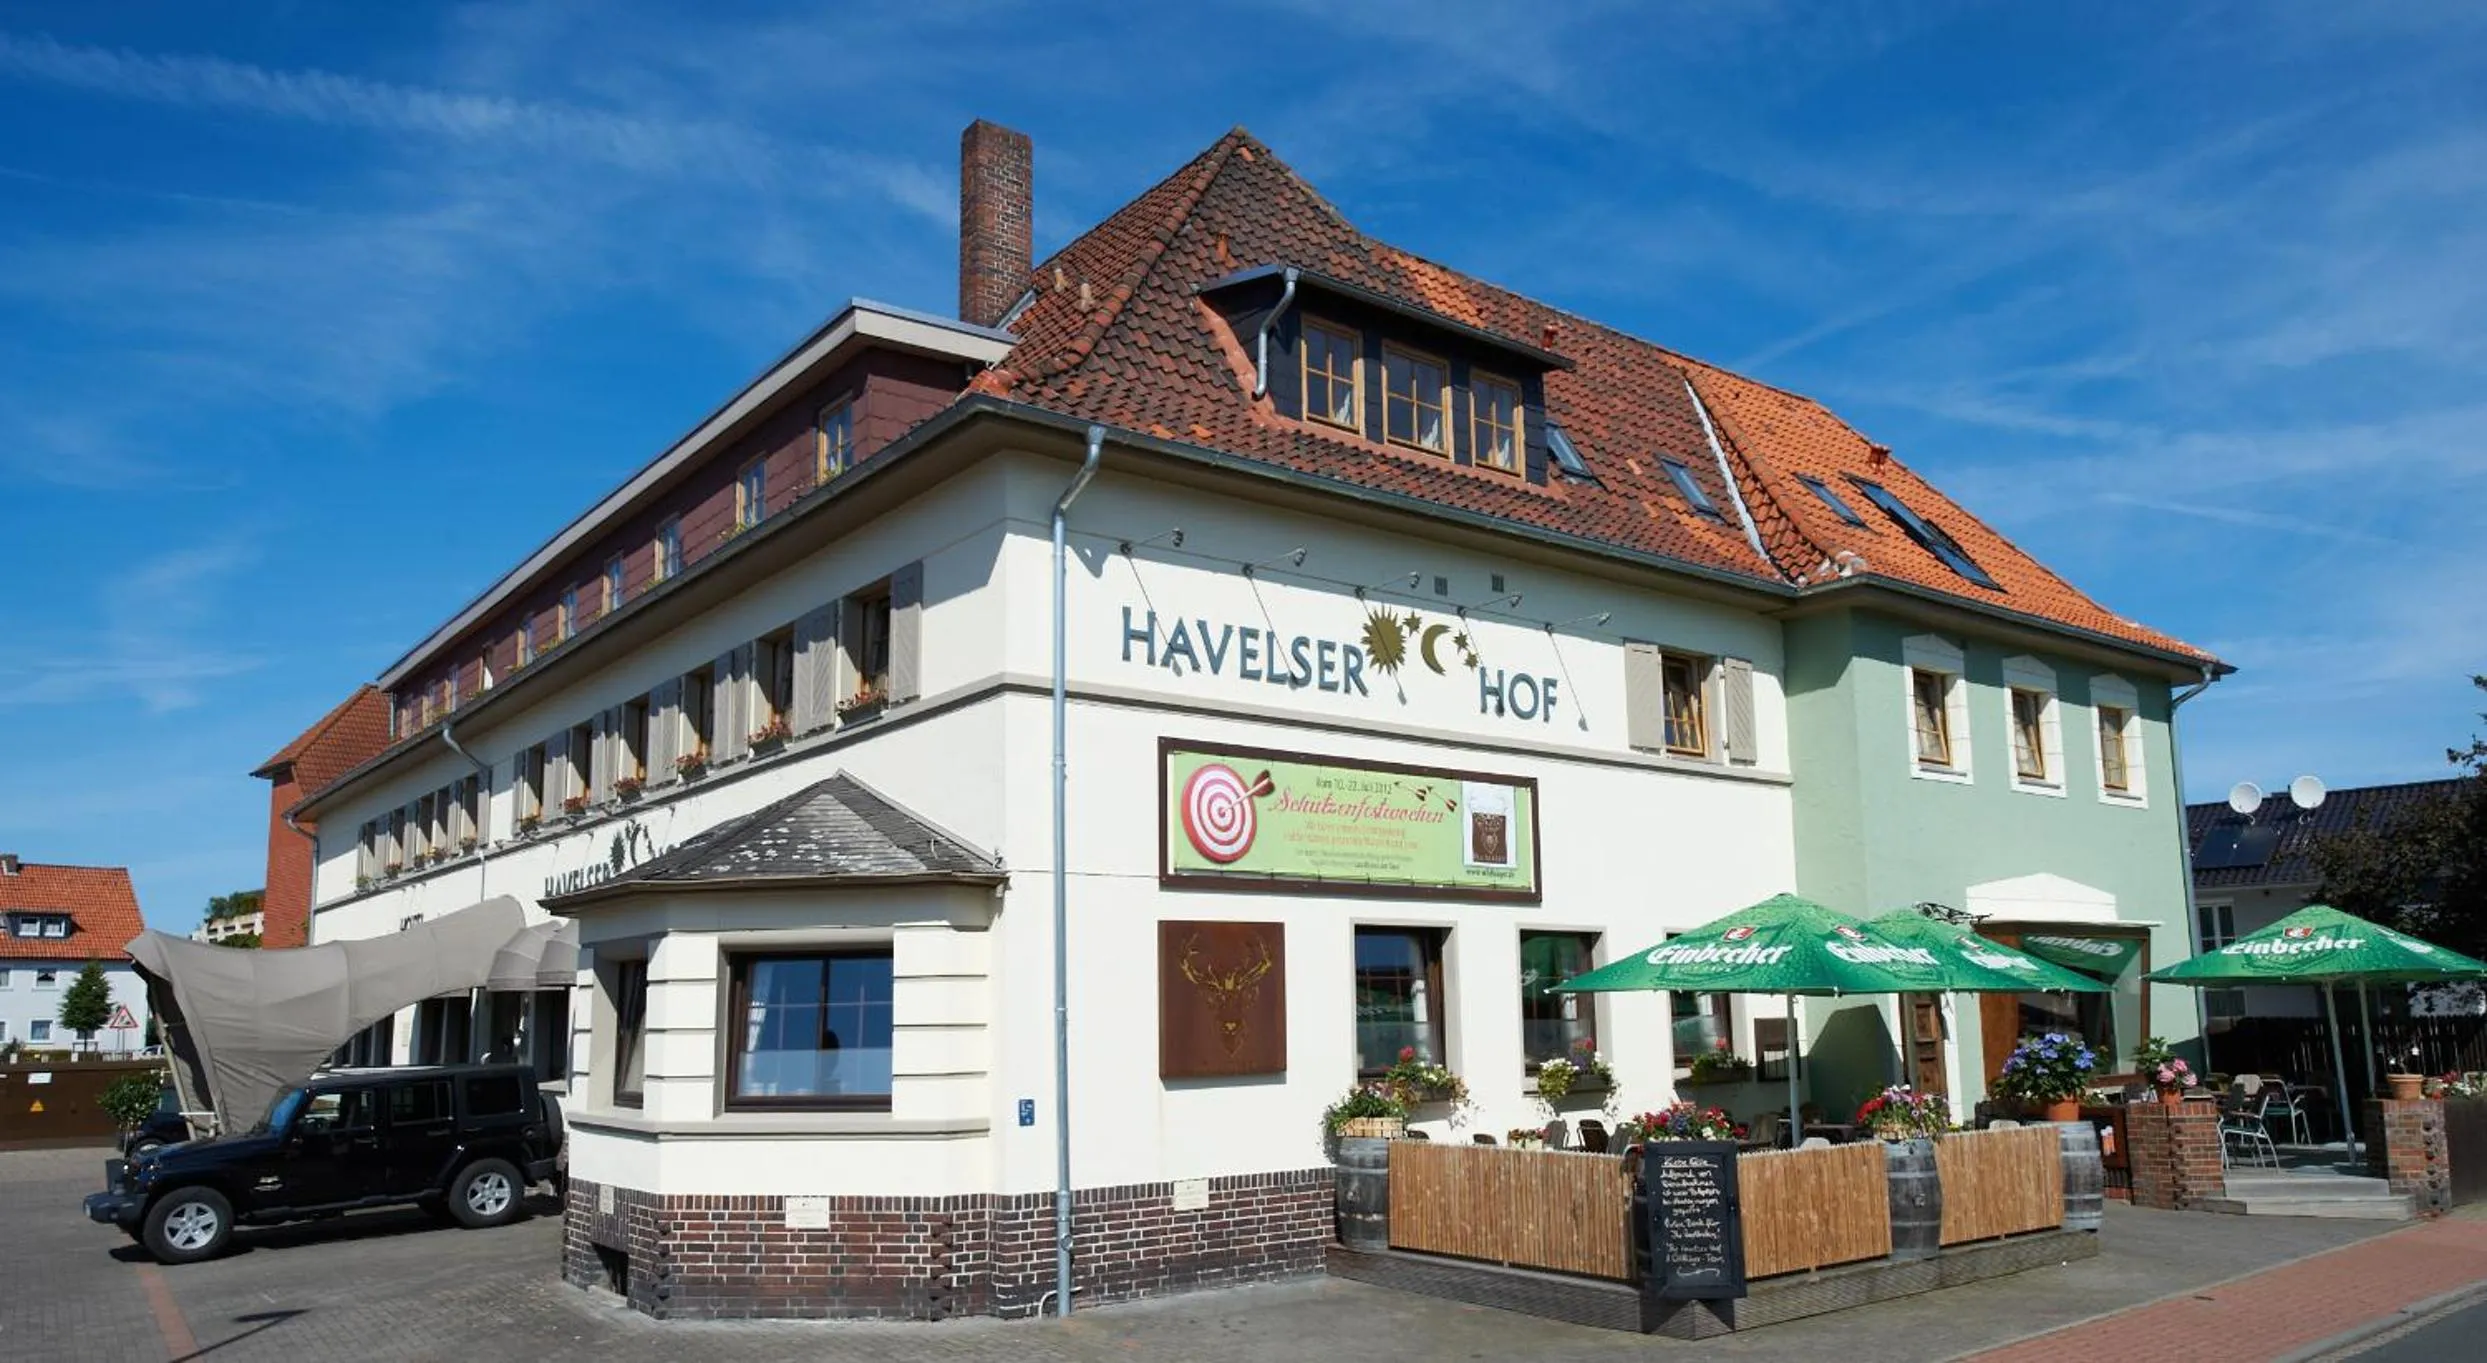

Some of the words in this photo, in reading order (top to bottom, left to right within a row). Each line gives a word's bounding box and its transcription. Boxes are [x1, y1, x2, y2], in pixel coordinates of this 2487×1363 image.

[1121, 605, 1369, 697] HAVELSER
[1479, 665, 1558, 723] HOF
[1647, 941, 1793, 965] Einbecher
[2220, 934, 2366, 955] Einbecher
